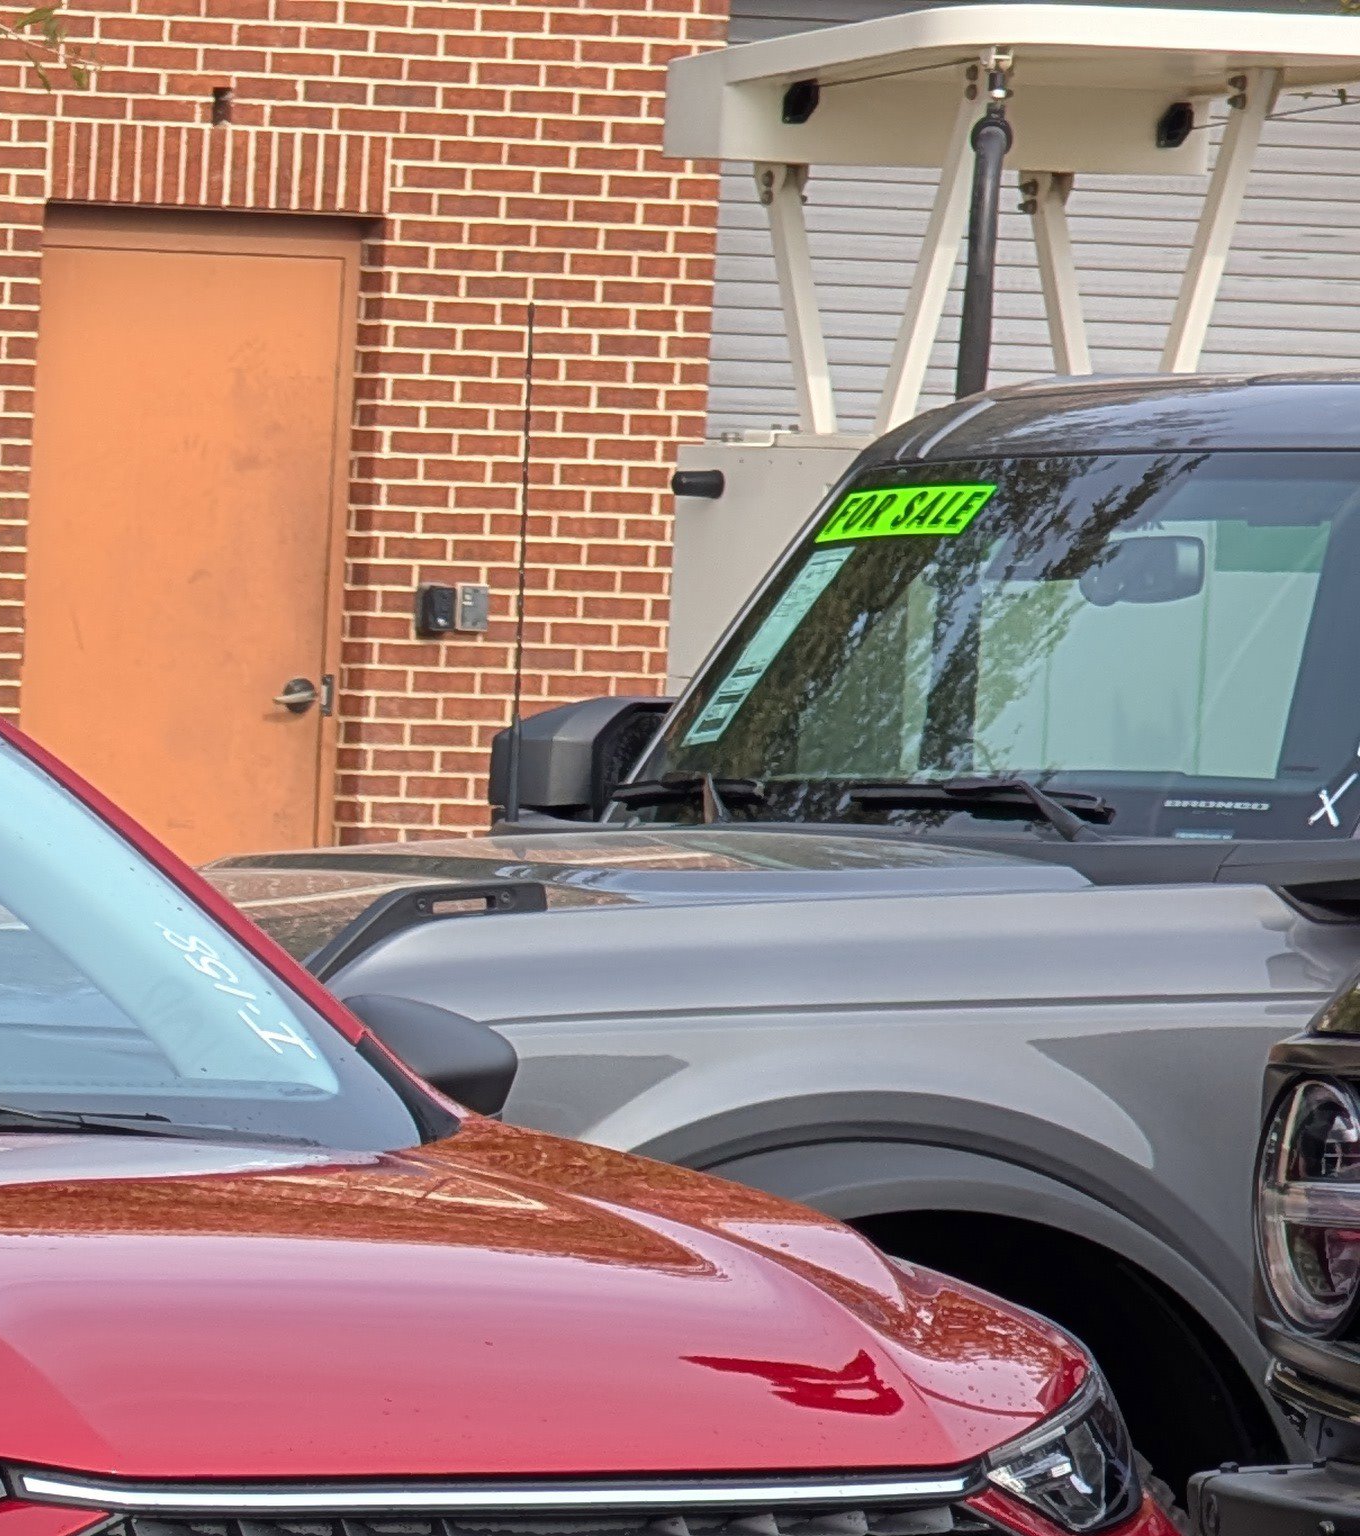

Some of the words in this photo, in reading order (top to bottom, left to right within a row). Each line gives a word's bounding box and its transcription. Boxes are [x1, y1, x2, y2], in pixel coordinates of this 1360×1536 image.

[824, 494, 898, 535] FOR
[890, 490, 988, 530] SALE
[1163, 799, 1270, 811] BRONCO
